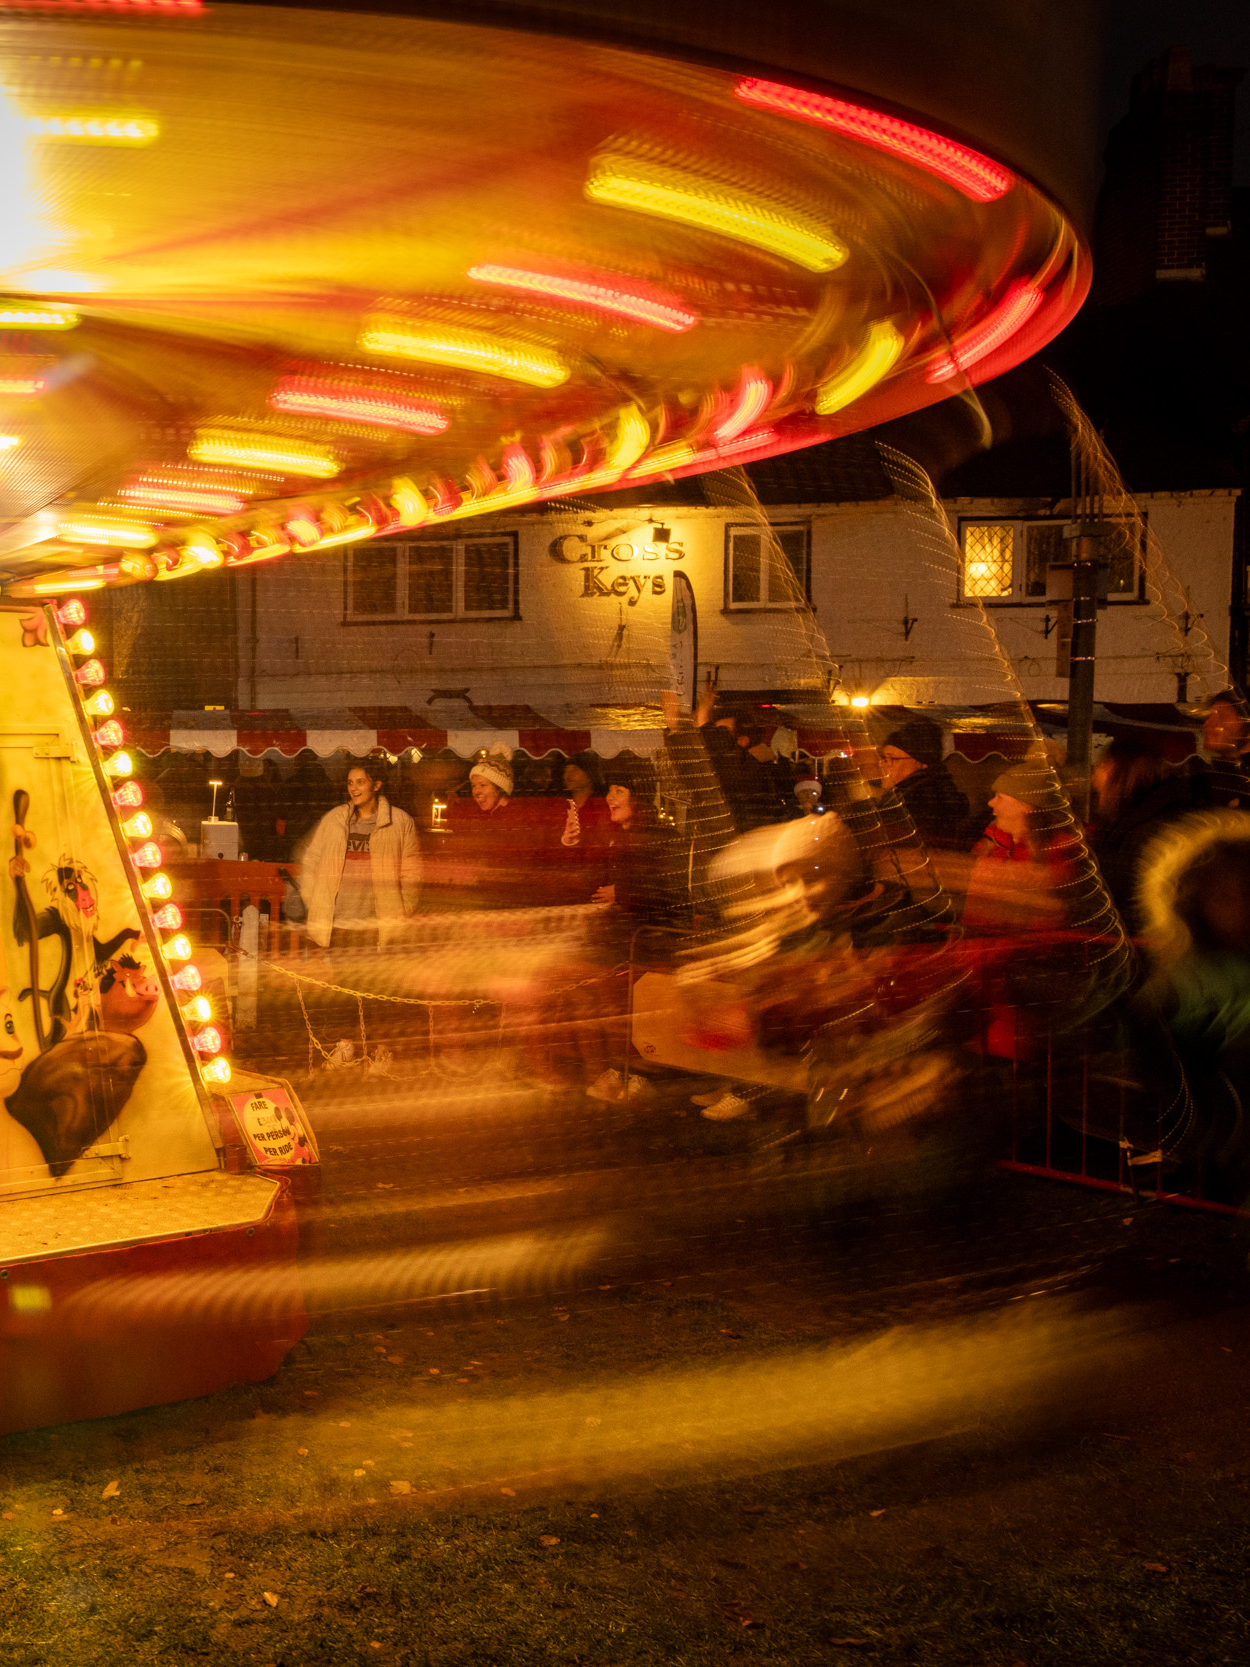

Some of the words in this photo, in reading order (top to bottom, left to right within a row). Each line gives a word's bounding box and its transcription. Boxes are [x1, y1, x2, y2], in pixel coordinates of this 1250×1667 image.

[548, 534, 686, 564] Cross
[579, 566, 667, 607] Keys
[250, 1100, 269, 1112] FARE
[252, 1133, 267, 1141] PER
[263, 1146, 279, 1156] PER
[278, 1142, 293, 1156] RIDE
